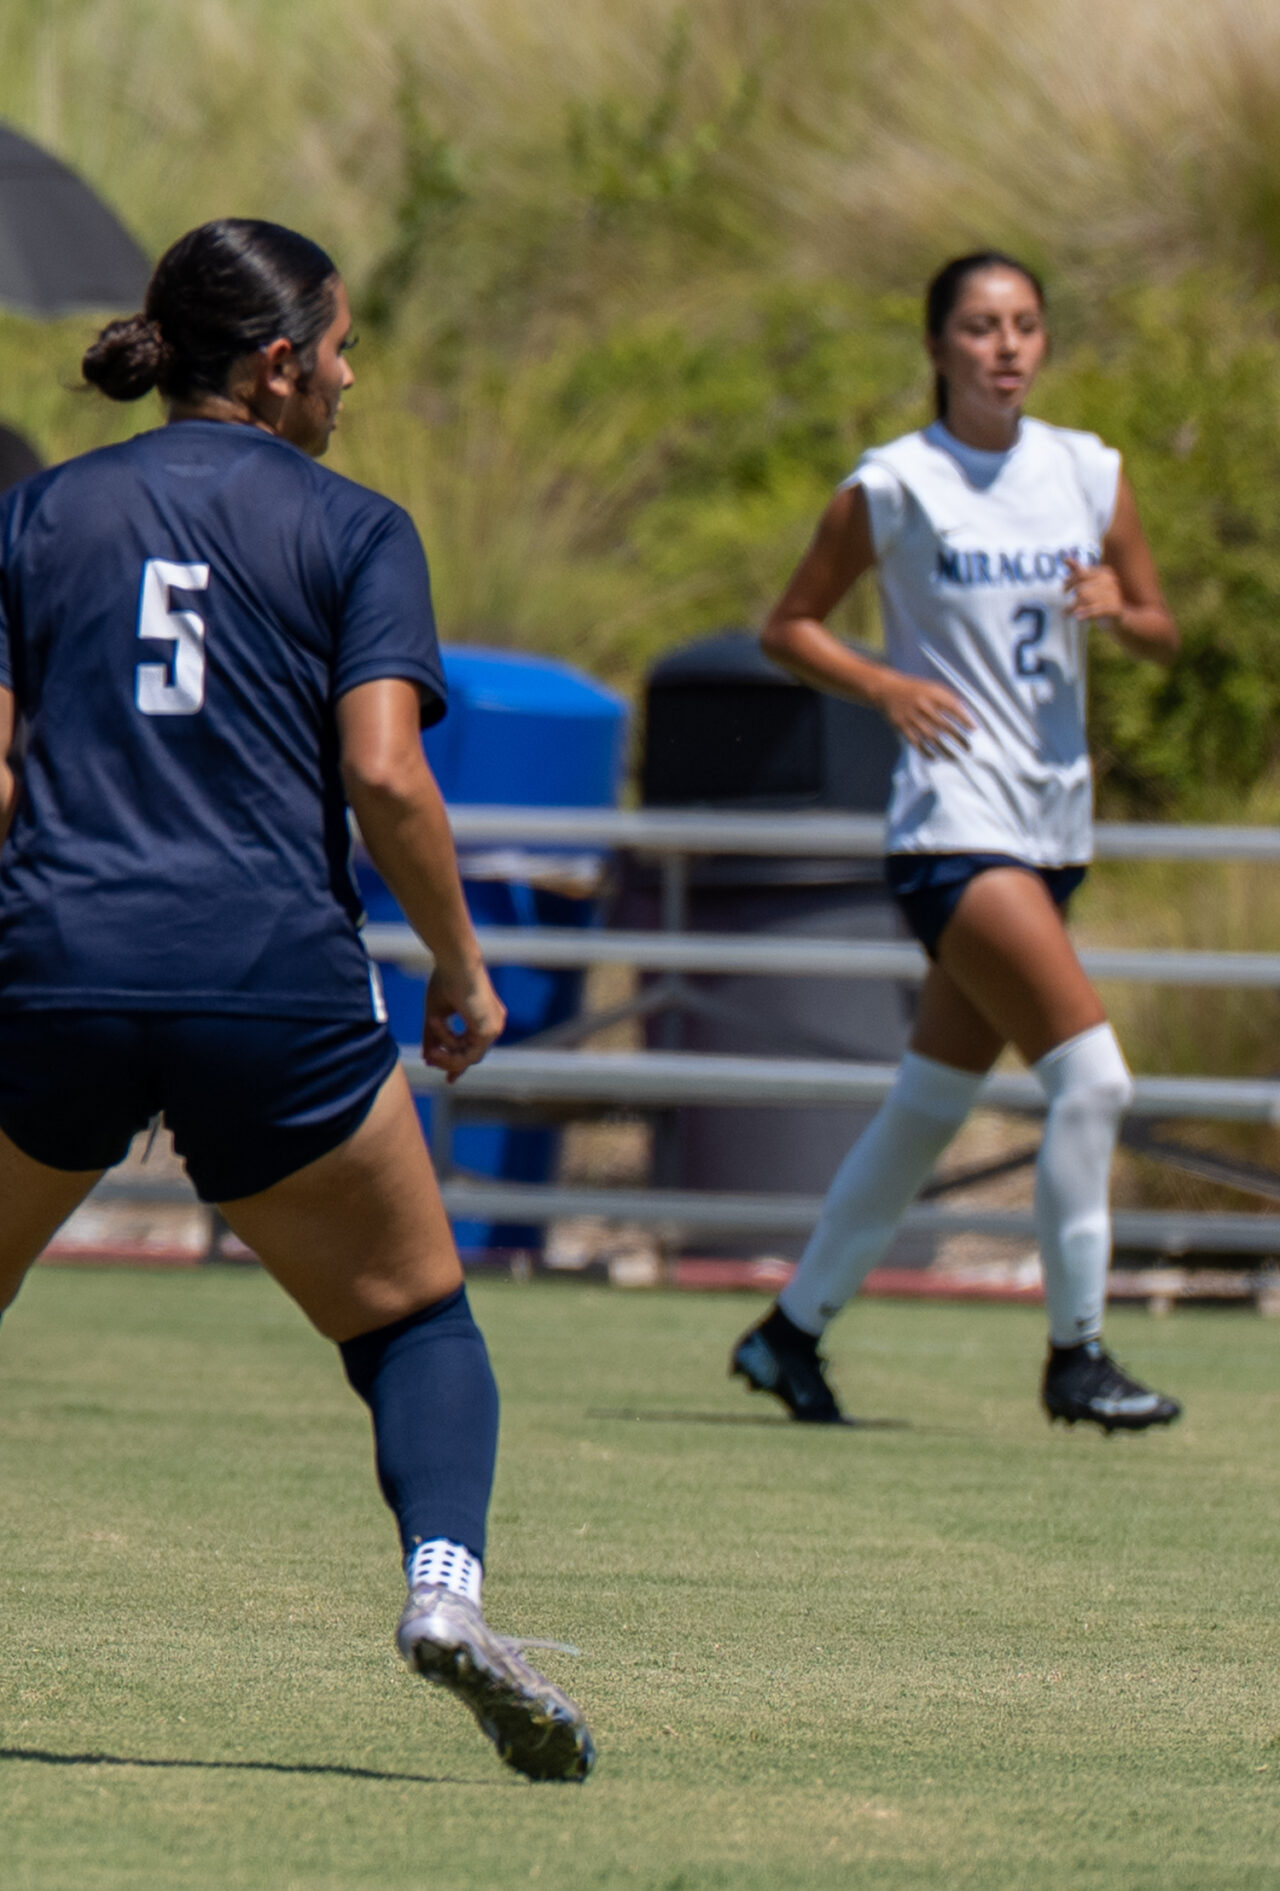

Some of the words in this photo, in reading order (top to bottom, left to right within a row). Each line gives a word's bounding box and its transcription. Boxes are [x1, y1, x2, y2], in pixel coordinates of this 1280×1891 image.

[937, 545, 1100, 583] MIRACOS
[136, 557, 210, 715] 5
[1012, 604, 1047, 677] 2
